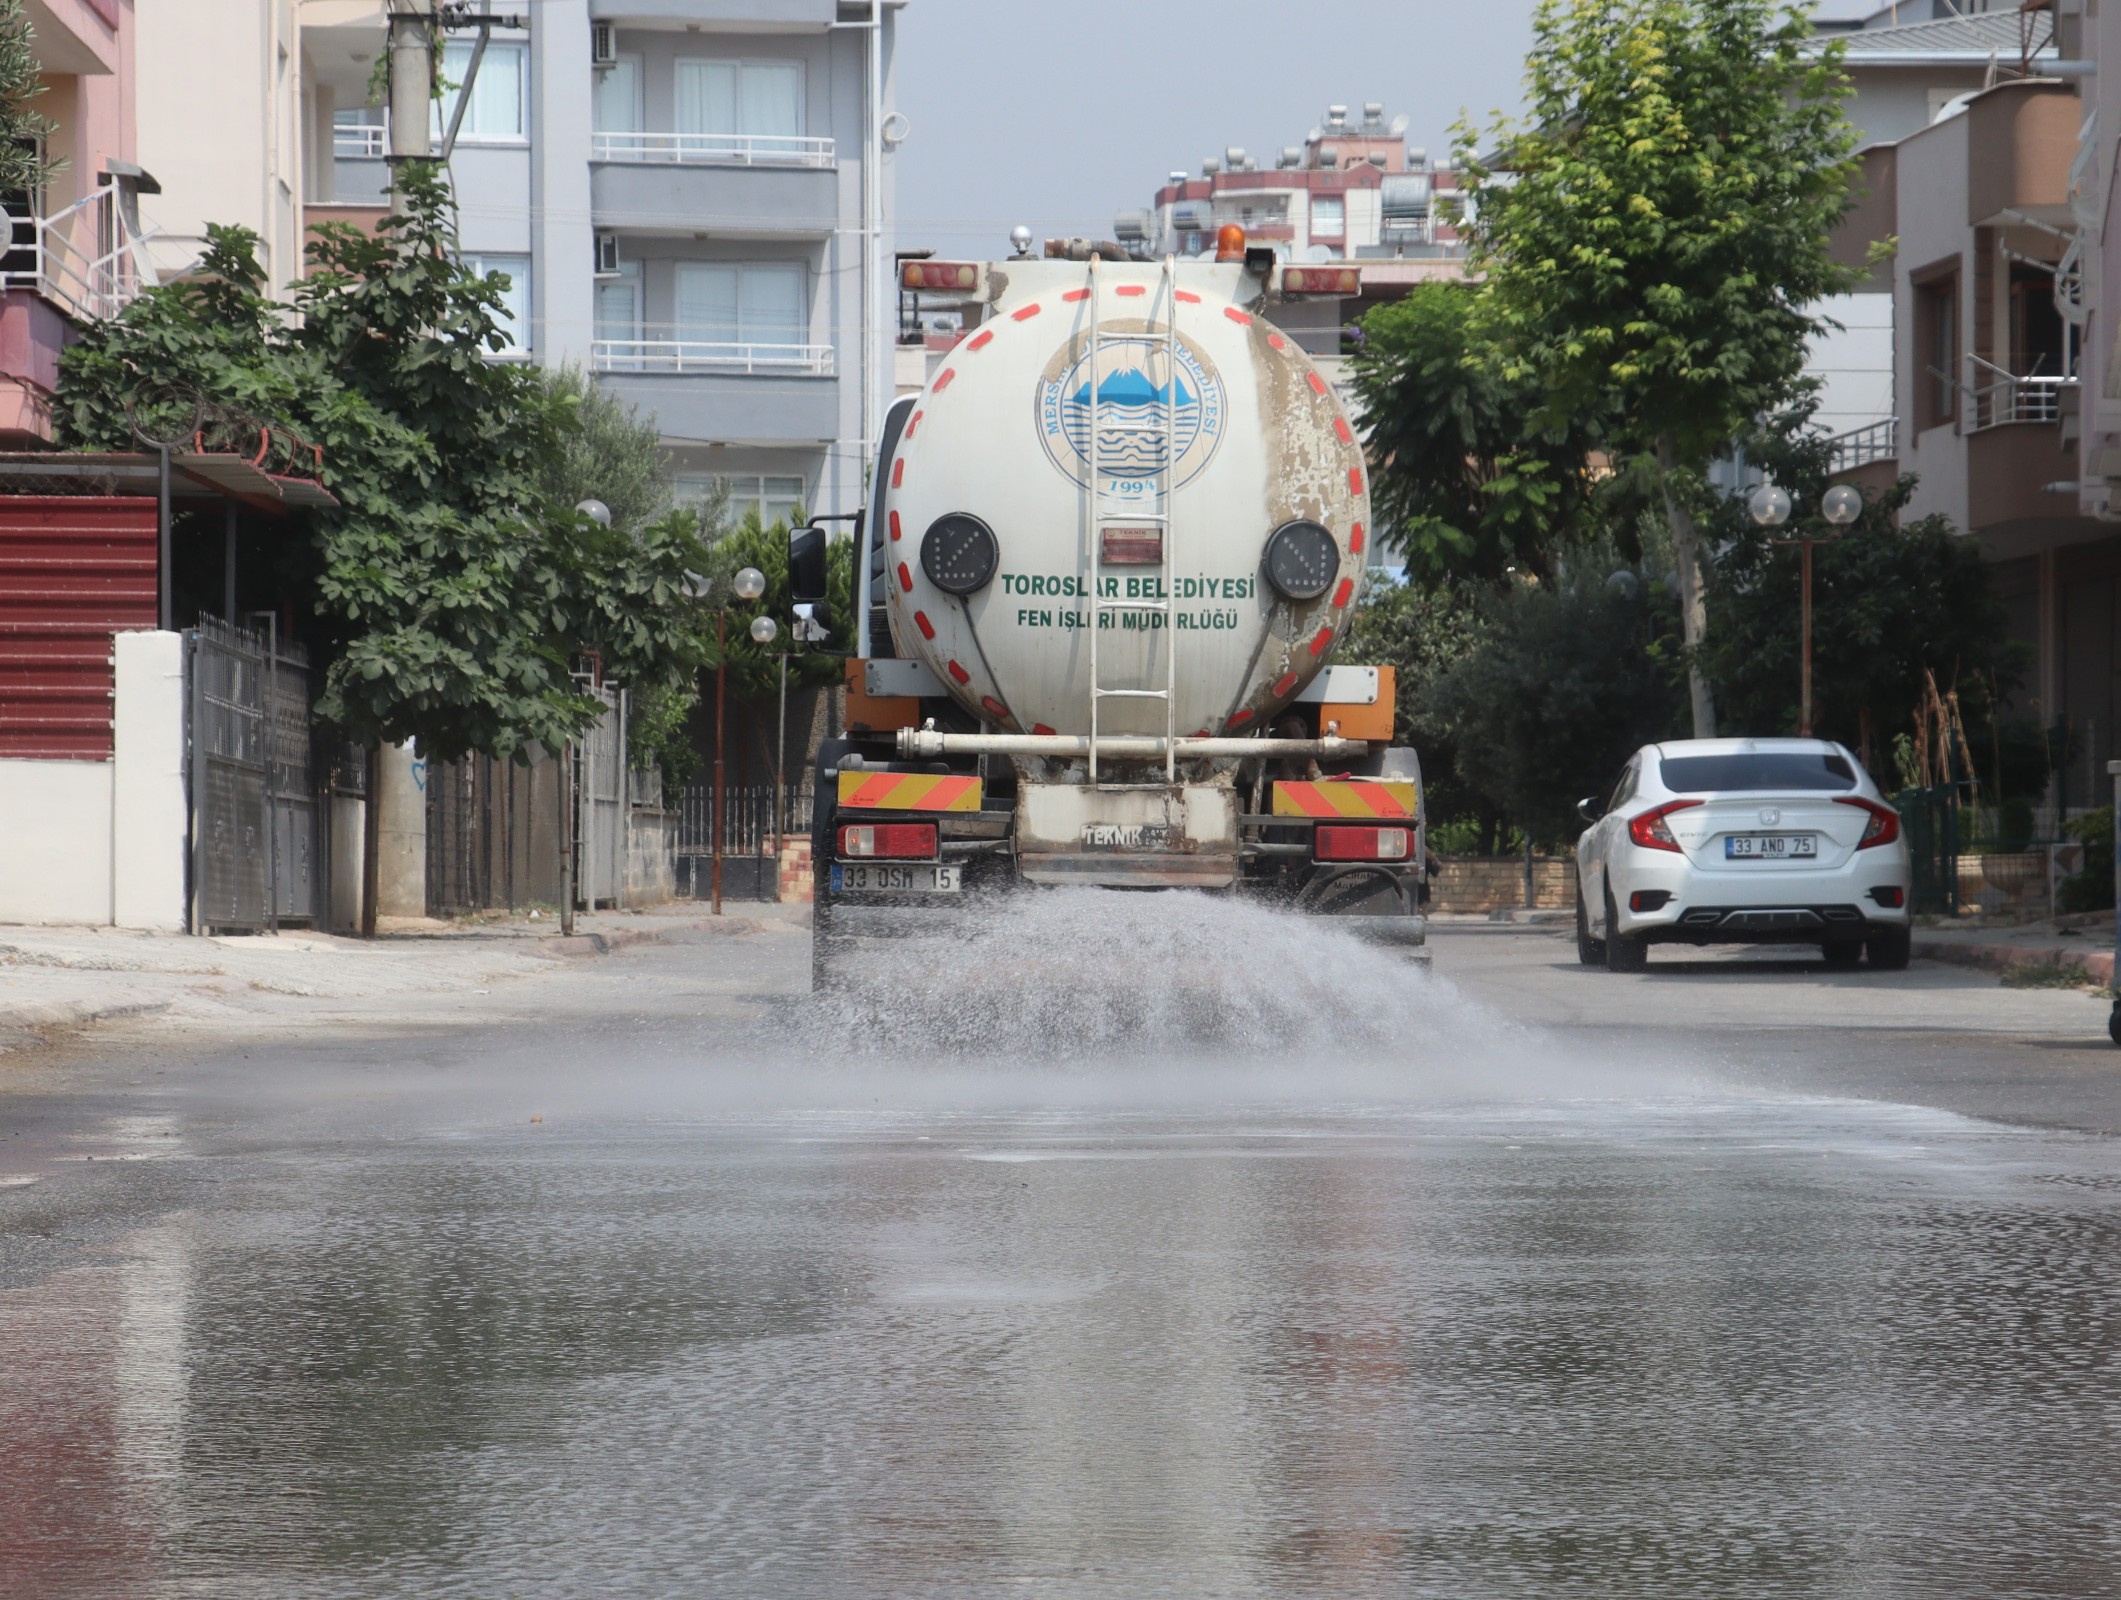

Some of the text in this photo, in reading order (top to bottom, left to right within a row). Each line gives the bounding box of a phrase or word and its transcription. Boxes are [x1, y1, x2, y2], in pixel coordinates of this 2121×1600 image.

[1126, 572, 1255, 599] BELEDİYESİ
[1018, 609, 1052, 627] FEN
[1058, 606, 1116, 632] İŞLRİ
[1735, 838, 1810, 853] 33 AND 75
[844, 867, 866, 888] 33
[930, 868, 951, 889] 15
